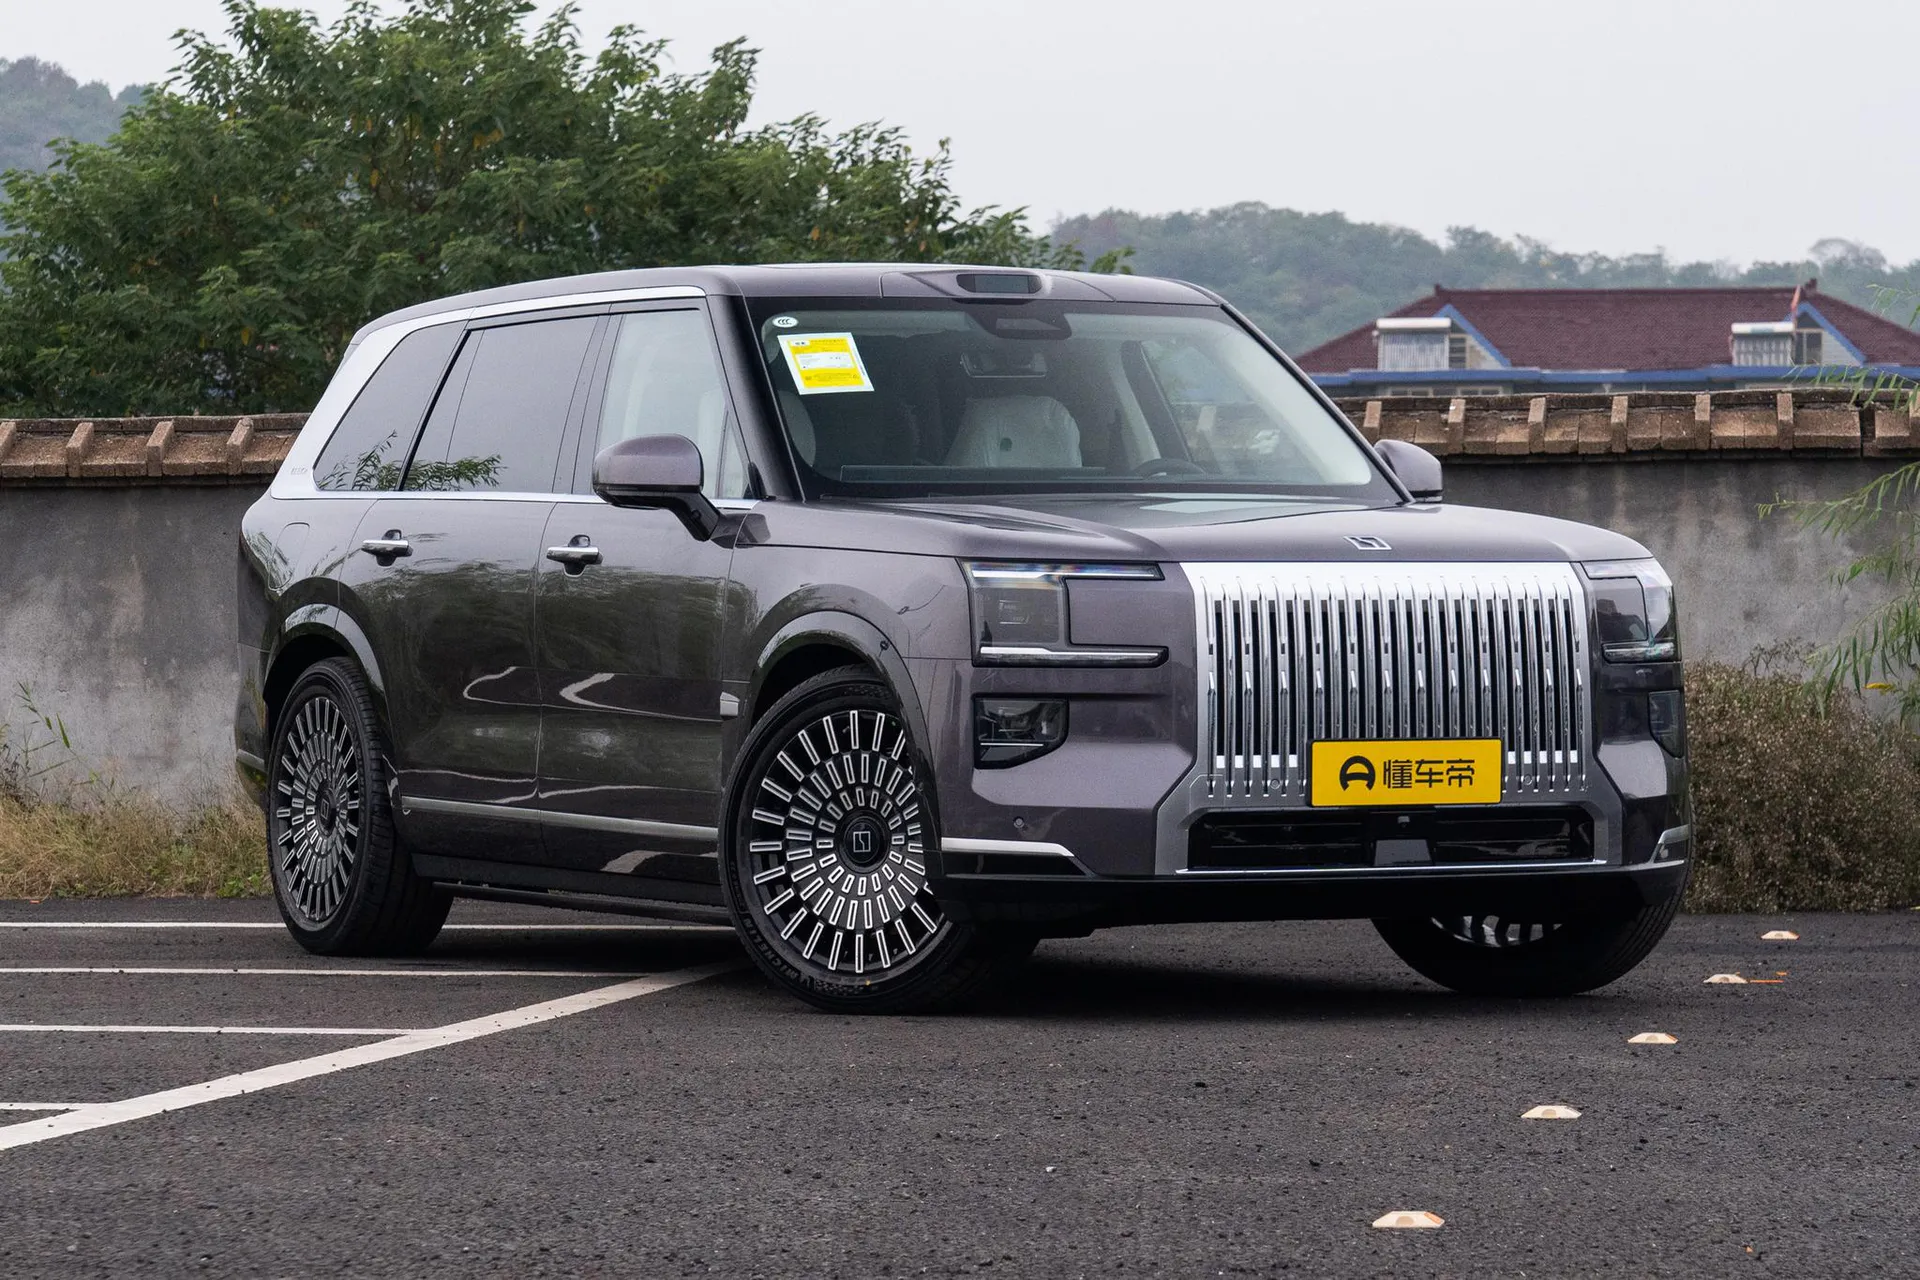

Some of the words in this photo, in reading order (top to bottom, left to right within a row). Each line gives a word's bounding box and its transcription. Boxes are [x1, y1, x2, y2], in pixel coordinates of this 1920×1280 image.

[1383, 758, 1475, 789] 懂车帝
[742, 916, 801, 981] MICHELIN
